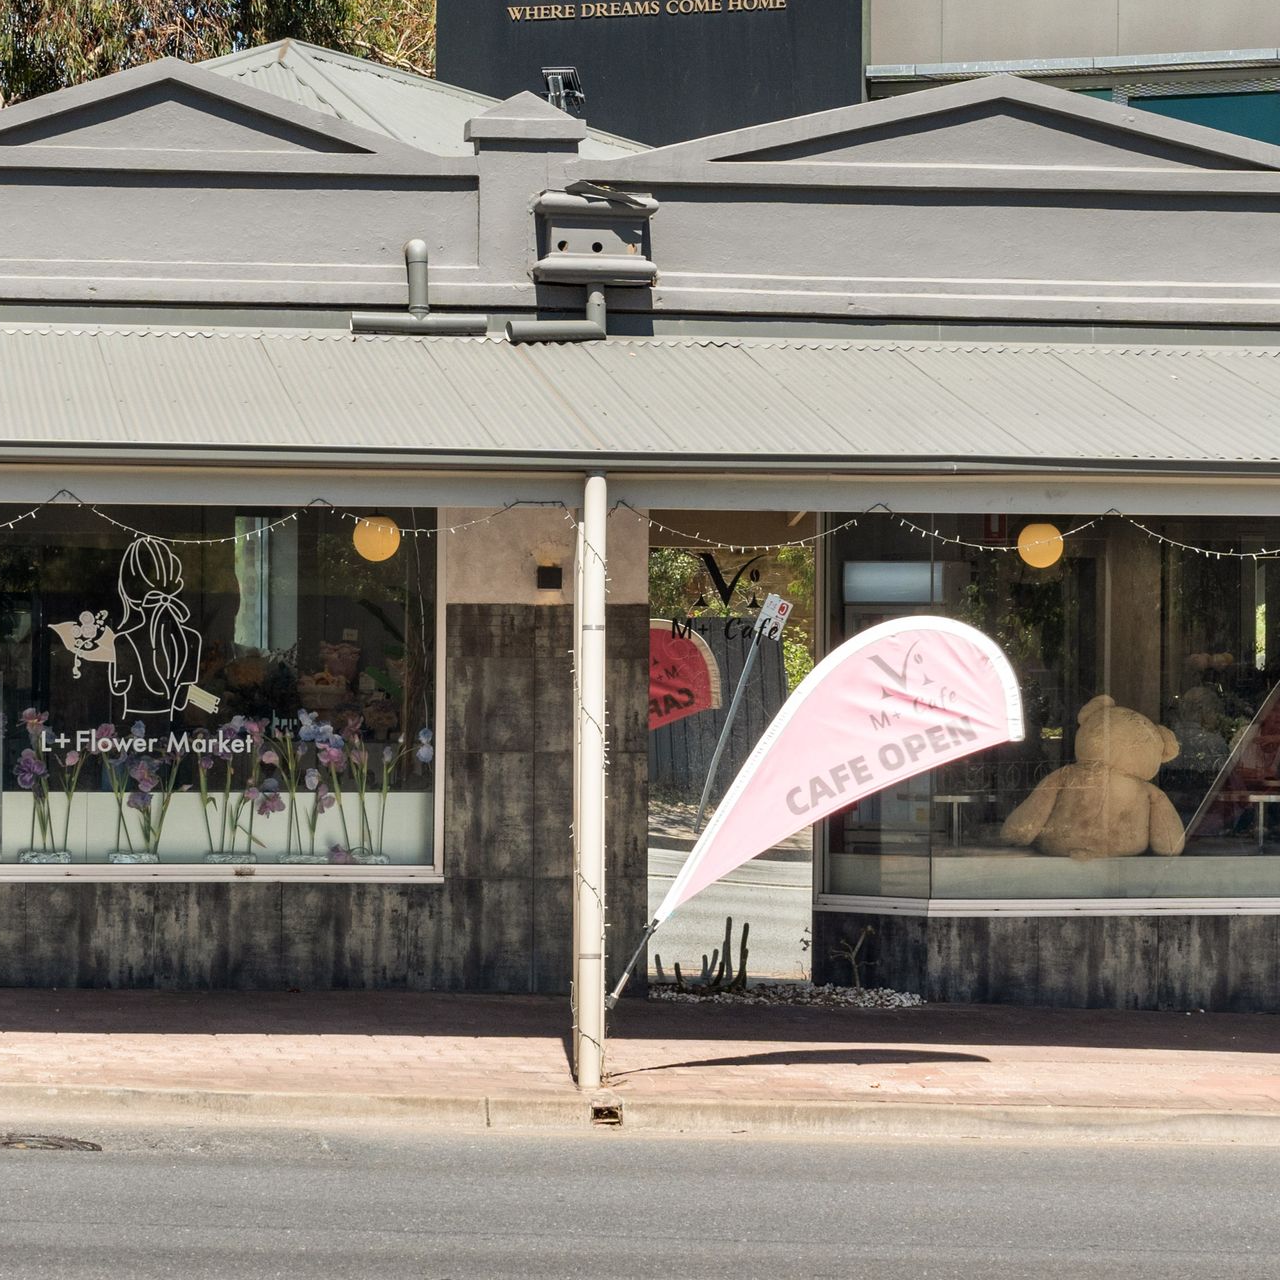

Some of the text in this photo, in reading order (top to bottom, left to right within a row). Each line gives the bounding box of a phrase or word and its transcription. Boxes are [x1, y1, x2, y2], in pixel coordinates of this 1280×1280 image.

[507, 4, 576, 21] WHERE
[580, 0, 661, 18] DREAMS
[724, 618, 779, 646] Cafe
[167, 729, 254, 754] Market
[786, 715, 979, 816] CAFE OPEN
